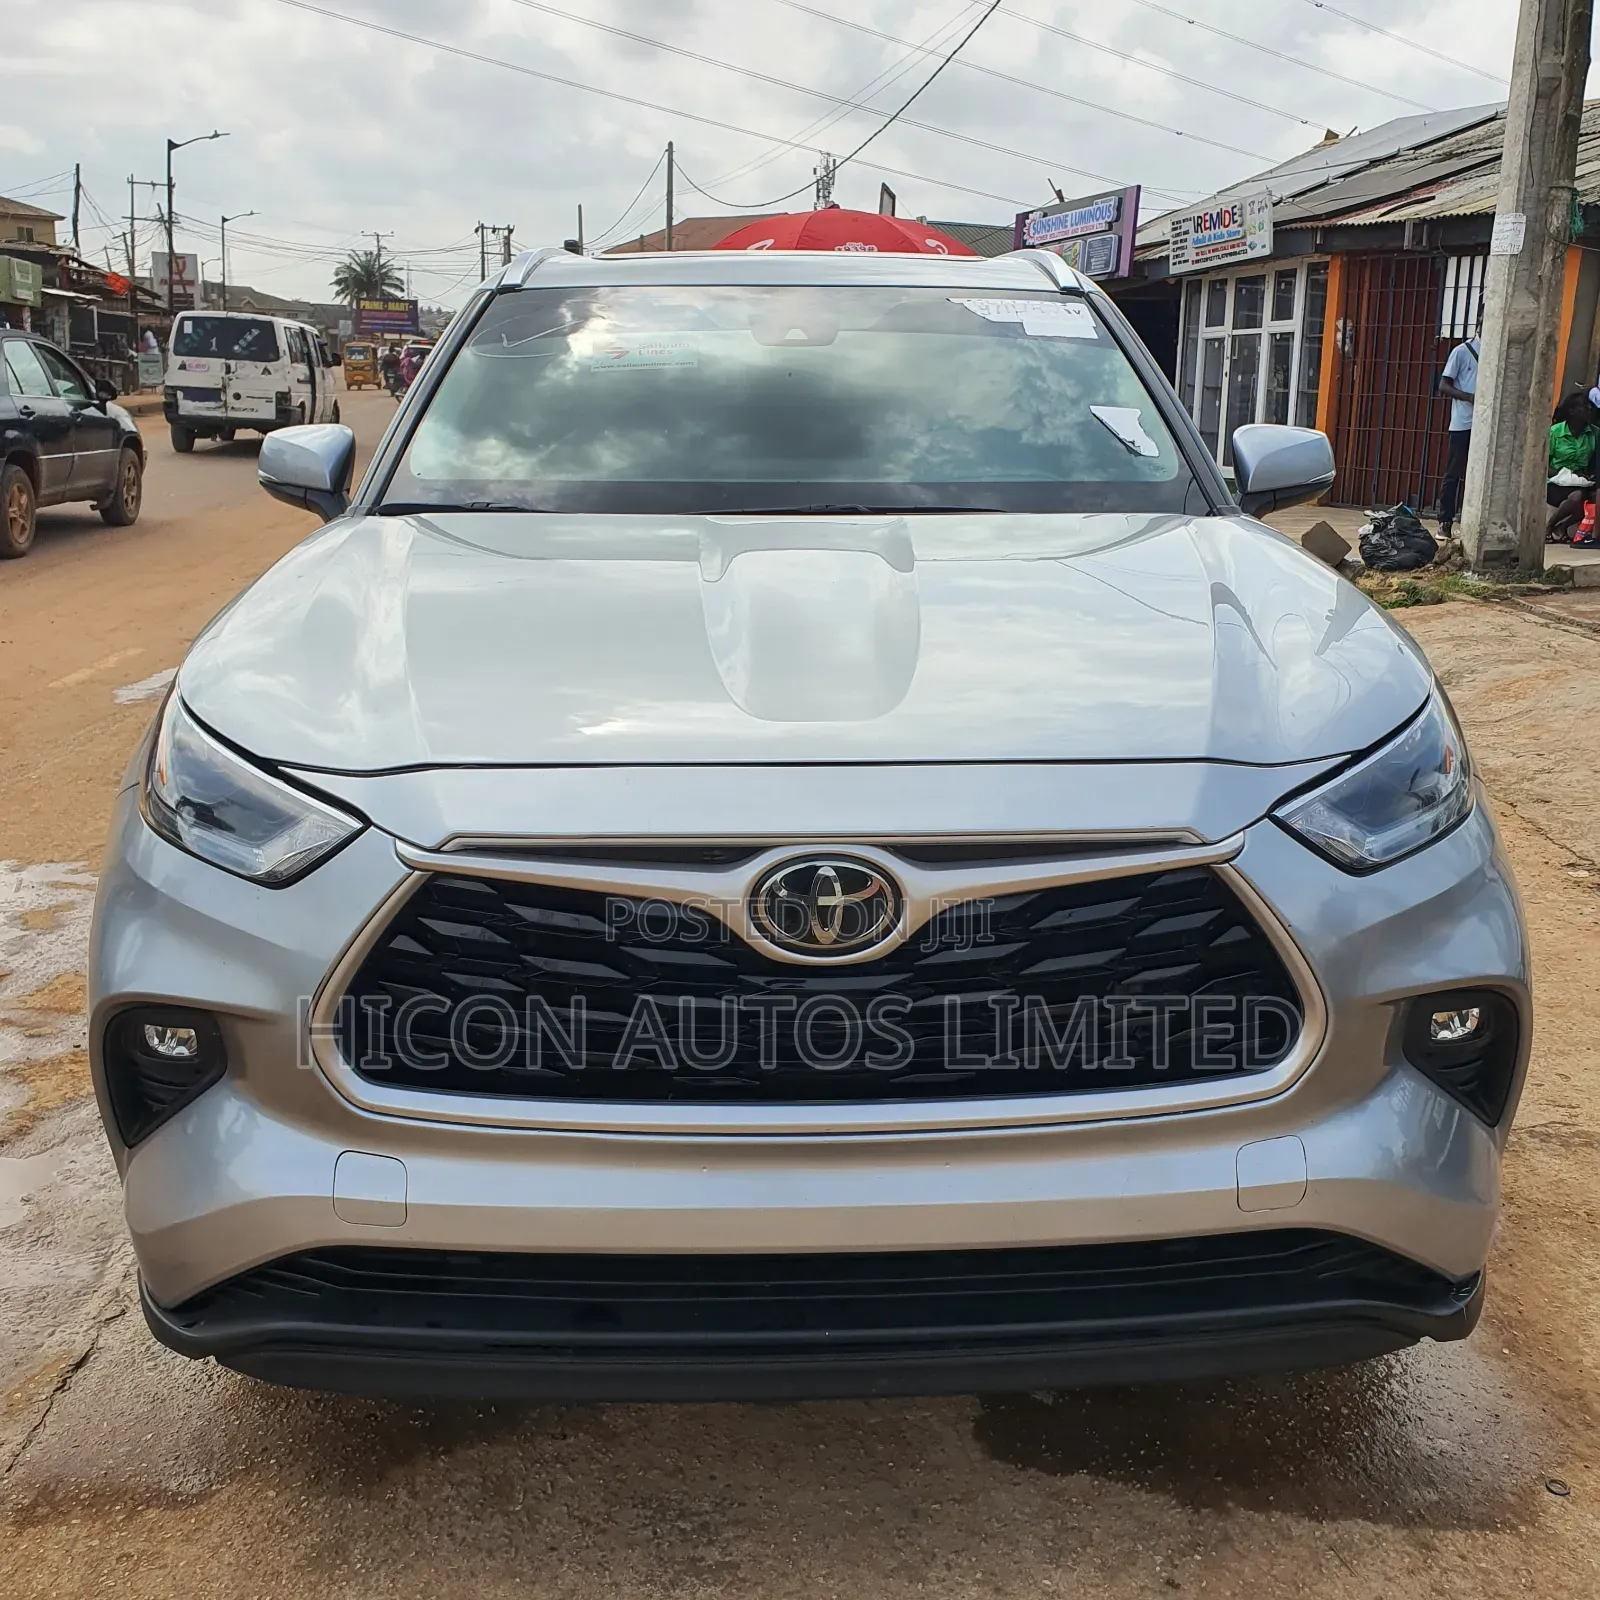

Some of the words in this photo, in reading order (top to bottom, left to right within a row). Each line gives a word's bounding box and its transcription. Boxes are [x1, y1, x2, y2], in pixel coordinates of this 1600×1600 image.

[1032, 213, 1068, 236] SUNSHINE
[1070, 203, 1113, 227] LUMINOUS
[1193, 204, 1238, 233] IREMIDE
[1049, 230, 1070, 239] SOLUTIONS
[1079, 225, 1095, 233] DESIGN
[1213, 231, 1225, 241] Kids
[1226, 229, 1241, 239] Store
